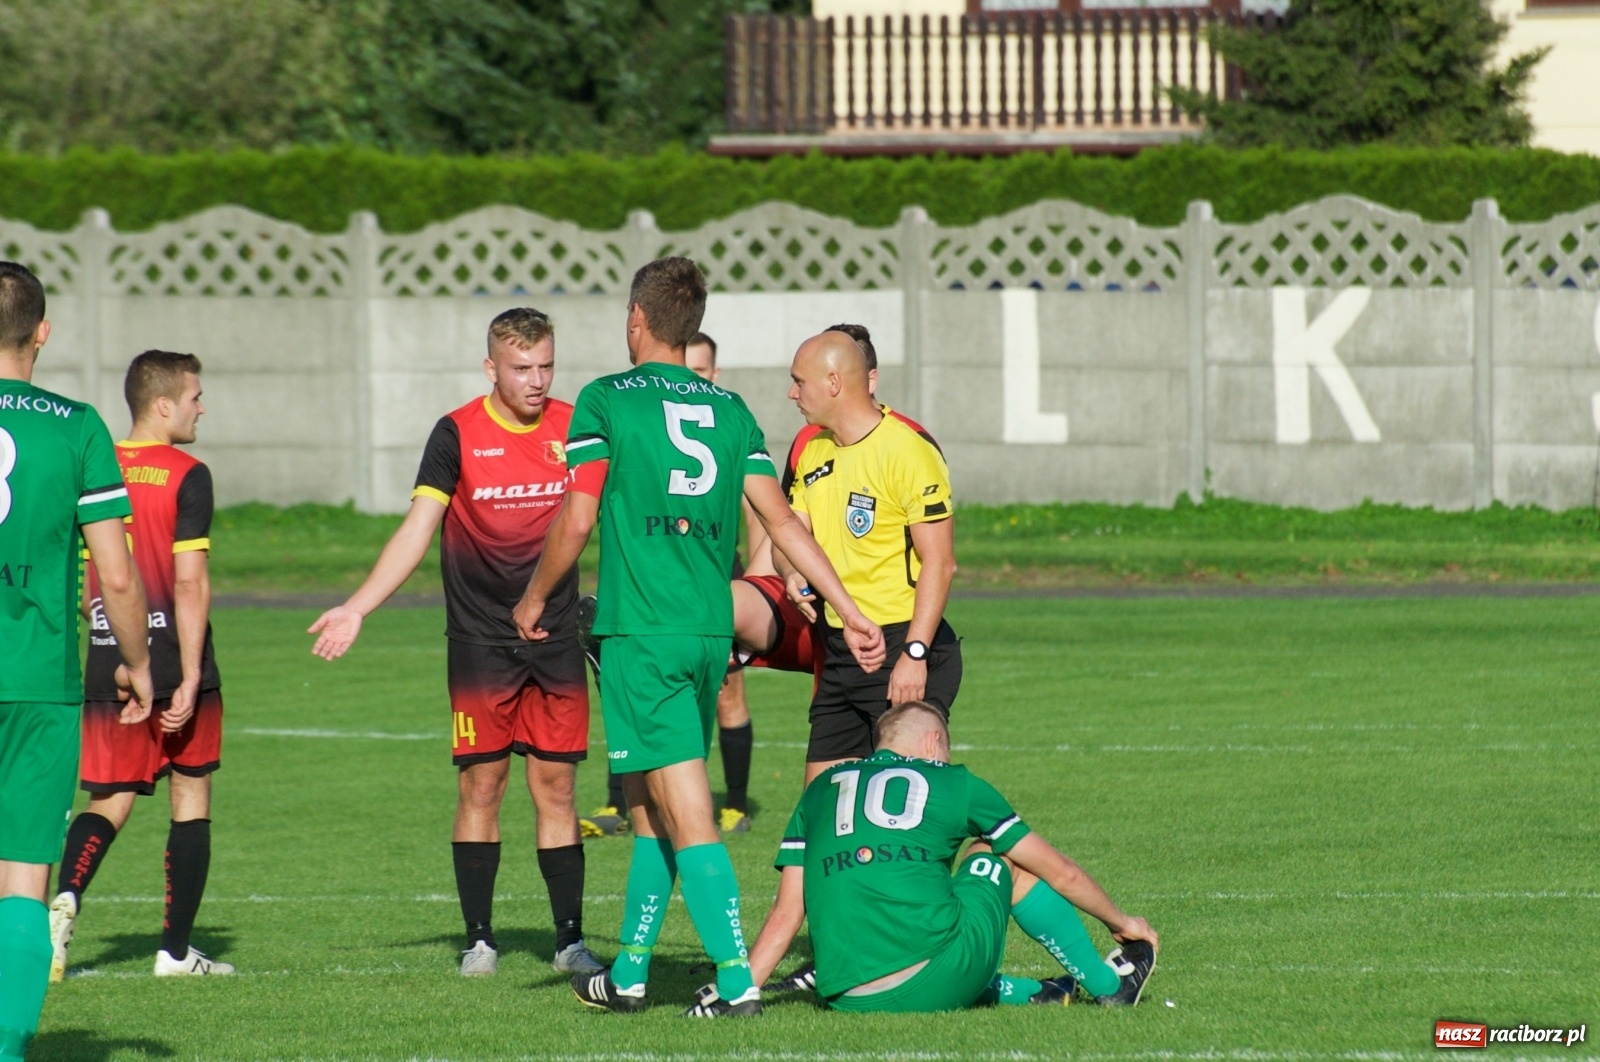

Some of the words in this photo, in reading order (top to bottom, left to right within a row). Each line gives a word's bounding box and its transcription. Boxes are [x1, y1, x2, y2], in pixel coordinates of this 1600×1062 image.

[613, 376, 647, 390] LKS
[0, 394, 72, 419] RKÓW
[481, 447, 505, 458] VIGO
[661, 399, 718, 497] 5
[493, 497, 563, 511] www.mazur-sc.
[453, 711, 477, 748] 14
[830, 767, 931, 838] 10
[821, 844, 932, 878] PROSAT
[628, 895, 659, 965] TWORKW
